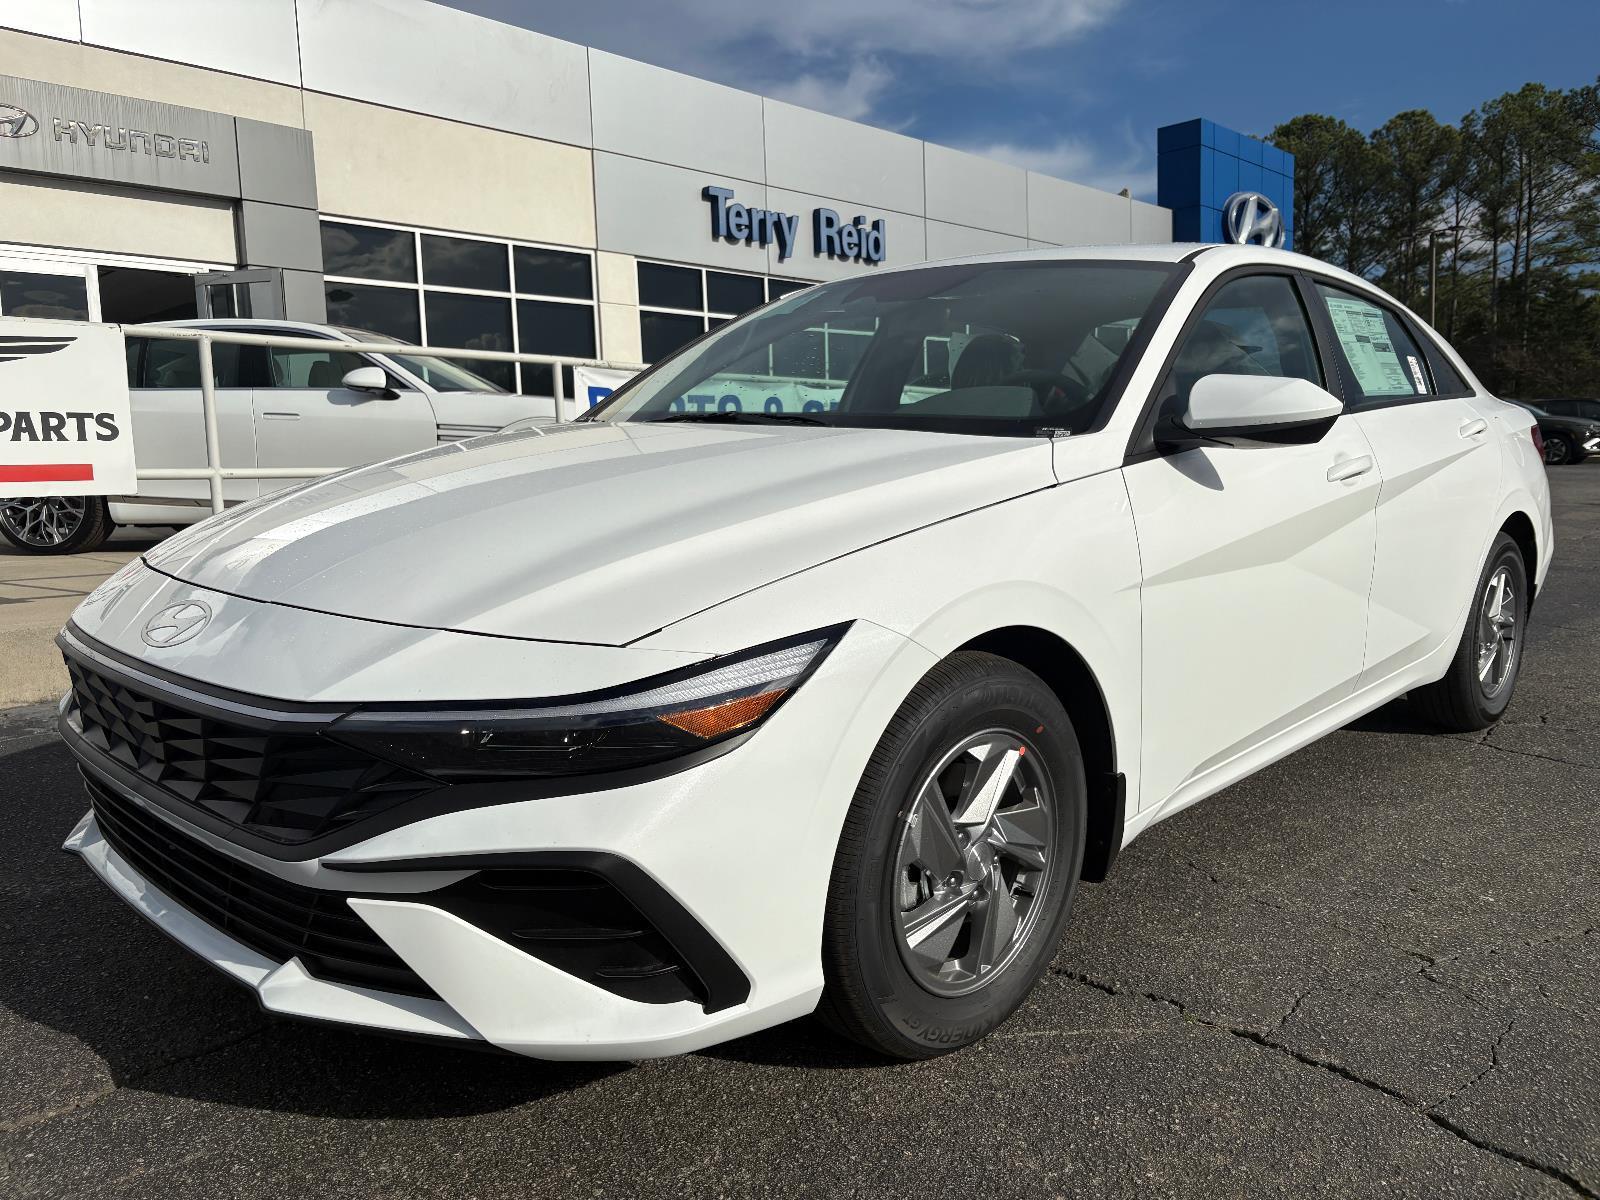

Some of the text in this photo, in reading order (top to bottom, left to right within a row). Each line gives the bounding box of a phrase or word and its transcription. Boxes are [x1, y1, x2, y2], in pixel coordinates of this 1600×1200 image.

[53, 117, 209, 164] HYUNDAI
[702, 186, 886, 263] Terry Reid
